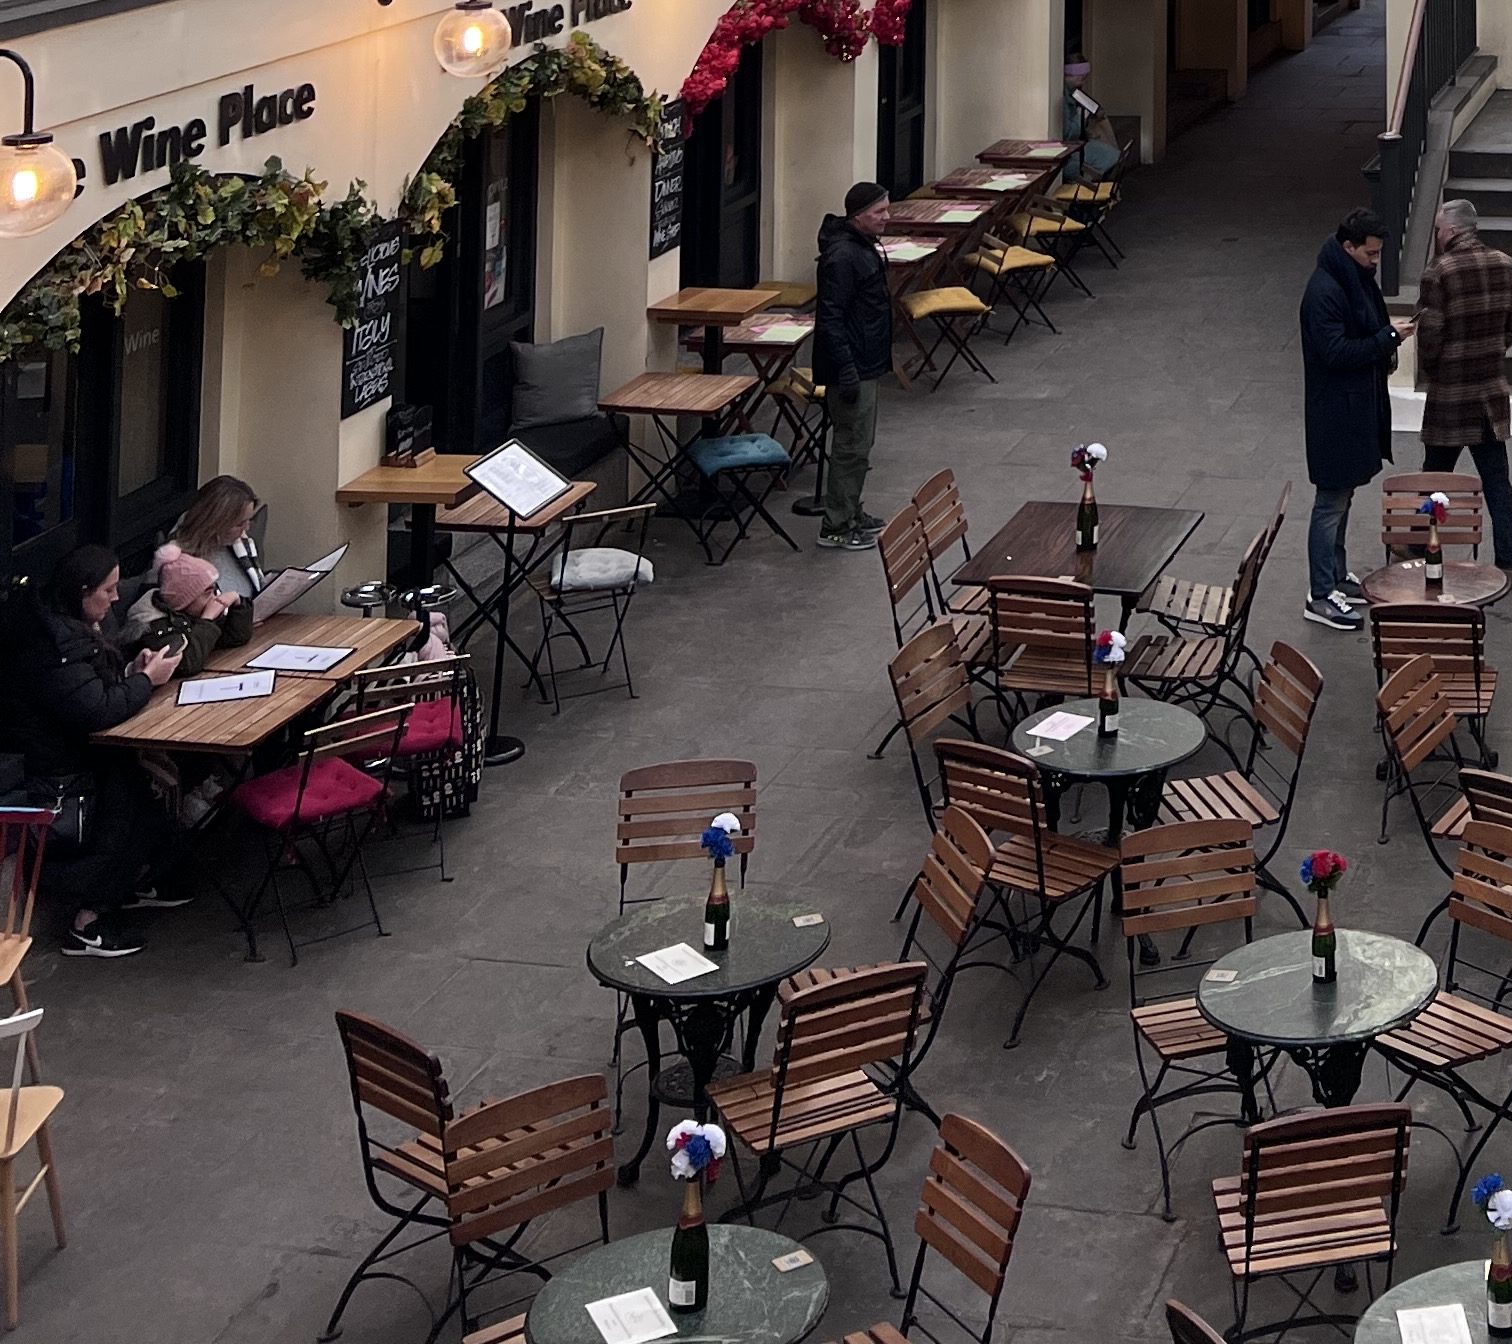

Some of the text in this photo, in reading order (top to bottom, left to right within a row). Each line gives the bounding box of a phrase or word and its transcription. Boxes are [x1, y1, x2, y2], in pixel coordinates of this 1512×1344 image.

[98, 115, 207, 186] Wine
[217, 83, 317, 148] Place
[124, 328, 160, 356] Wine
